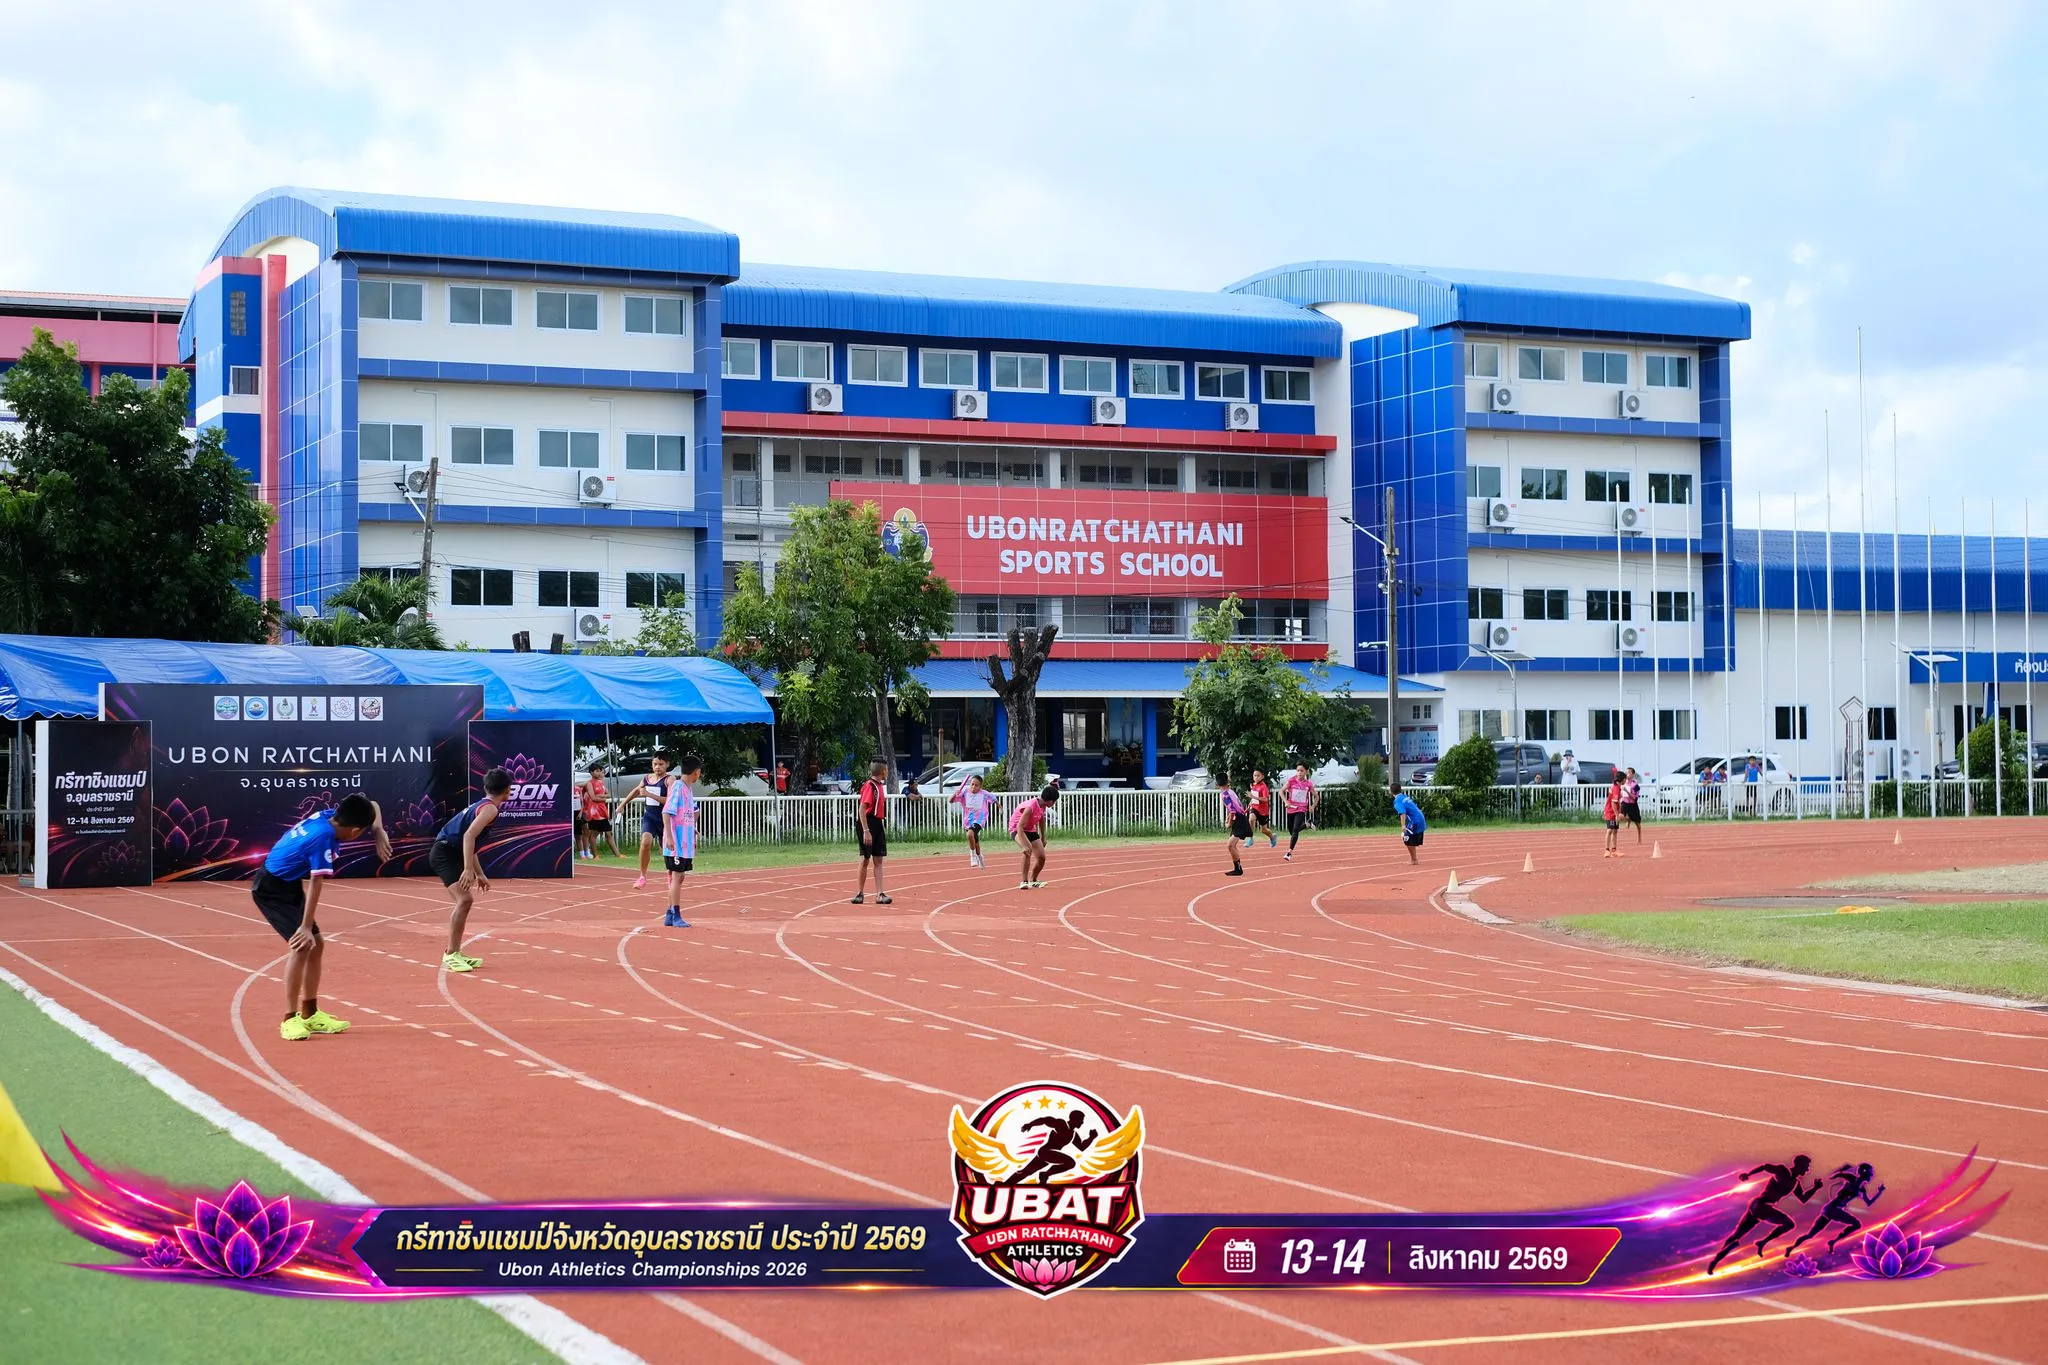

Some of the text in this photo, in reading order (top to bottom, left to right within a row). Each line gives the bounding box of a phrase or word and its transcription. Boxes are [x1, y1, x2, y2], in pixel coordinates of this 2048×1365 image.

[967, 515, 1243, 546] UBONRATCHATHANI
[1000, 549, 1223, 578] SPORTS SCHOOL
[2014, 658, 2048, 674] ห้องป
[168, 746, 432, 764] UBON RATCHATHANI
[240, 774, 361, 792] จ.อุบลราชธานี
[508, 784, 559, 800] BON
[499, 801, 555, 809] THLETICS
[90, 816, 116, 825] สิงหาคม
[117, 816, 135, 824] 2569
